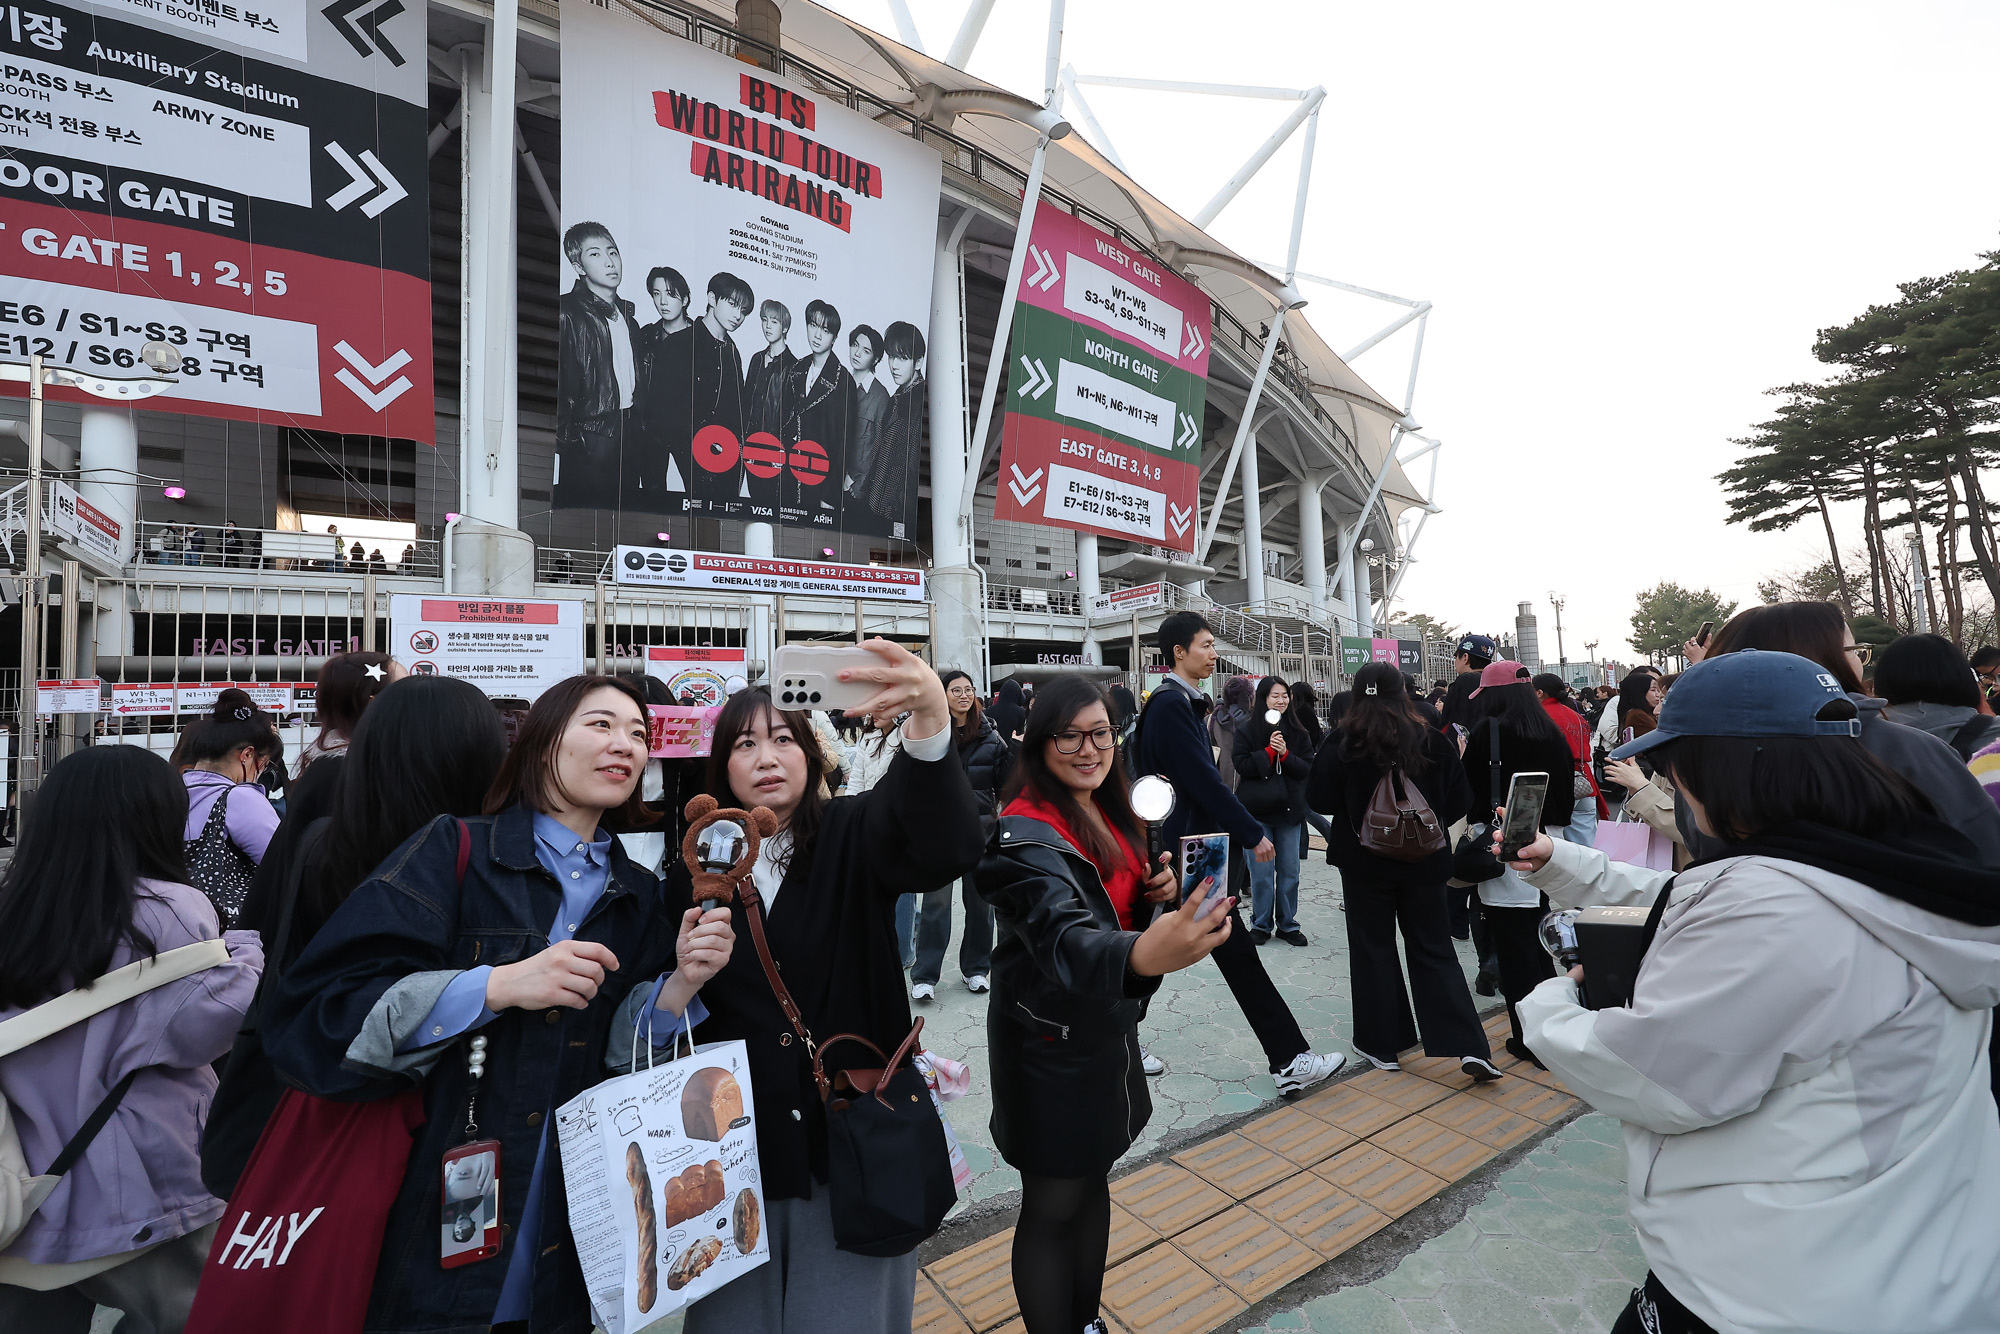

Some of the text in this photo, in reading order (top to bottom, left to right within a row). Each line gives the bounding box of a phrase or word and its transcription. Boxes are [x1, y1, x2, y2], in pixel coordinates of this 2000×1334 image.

[166, 5, 217, 28] BOOTH
[244, 10, 280, 34] 부스
[86, 41, 299, 109] Auxiliary Stadium
[74, 80, 114, 103] 부스
[749, 76, 806, 130] BTS
[0, 104, 142, 146] CK석 전용 부스
[152, 100, 275, 142] ARMY ZONE
[668, 89, 871, 199] WORLD TOUR
[0, 159, 235, 228] OOR GATE
[703, 146, 843, 226] ARIRANG
[745, 221, 804, 245] GOYANG STADIUM
[760, 215, 790, 231] GOYANG
[729, 228, 818, 261] 2026.04.09. THU 7PM(KST)
[729, 239, 817, 270] 2026.04.11. SAT 7PM(KST)
[21, 228, 288, 296] GATE 1, 2, 5
[728, 250, 818, 281] 2026.04.12. SUN 7PM(KST)
[1095, 238, 1162, 288] WEST GATE
[1111, 285, 1147, 313] W1~W8
[1084, 290, 1166, 340] S3~S4, S9~S11 구역
[0, 301, 251, 359] E6 / S1~S3 구역
[65, 341, 78, 364] /
[88, 345, 202, 377] S68
[210, 359, 264, 388] 구역
[1085, 338, 1159, 384] NORTH GATE
[1077, 385, 1158, 427] N1~N5, N6~N11 구역
[1060, 438, 1161, 481] EAST GATE 3, 4, 8
[751, 505, 773, 517] VISA
[1069, 481, 1149, 512] E1~E6 S1~S3 구역
[779, 513, 799, 522] Galaxy
[780, 507, 808, 516] SAMSUNG
[1063, 496, 1151, 528] E7~E12 S6~S8 구역
[1152, 547, 1168, 559] EAST
[700, 558, 915, 583] EAST GATE 1~4, 5, 8 E1~E12 S1~S3, S6~S8 구역
[712, 576, 907, 596] GENERAL석 입장 게이트 GENERAL SEATS ENTRANCE
[458, 603, 526, 615] 반입 금지 물품
[459, 614, 501, 622] Prohibited
[193, 636, 359, 656] EAST GATE 1
[447, 632, 470, 640] 생수를
[471, 632, 494, 640] 제외한
[512, 633, 533, 641] 음식물
[534, 633, 549, 641] 일체
[605, 643, 645, 658] EAST
[1037, 653, 1060, 665] EAST
[647, 1129, 671, 1138] WARM
[720, 1139, 744, 1155] Butter
[723, 1151, 748, 1172] wheat
[217, 1206, 325, 1270] HAY
